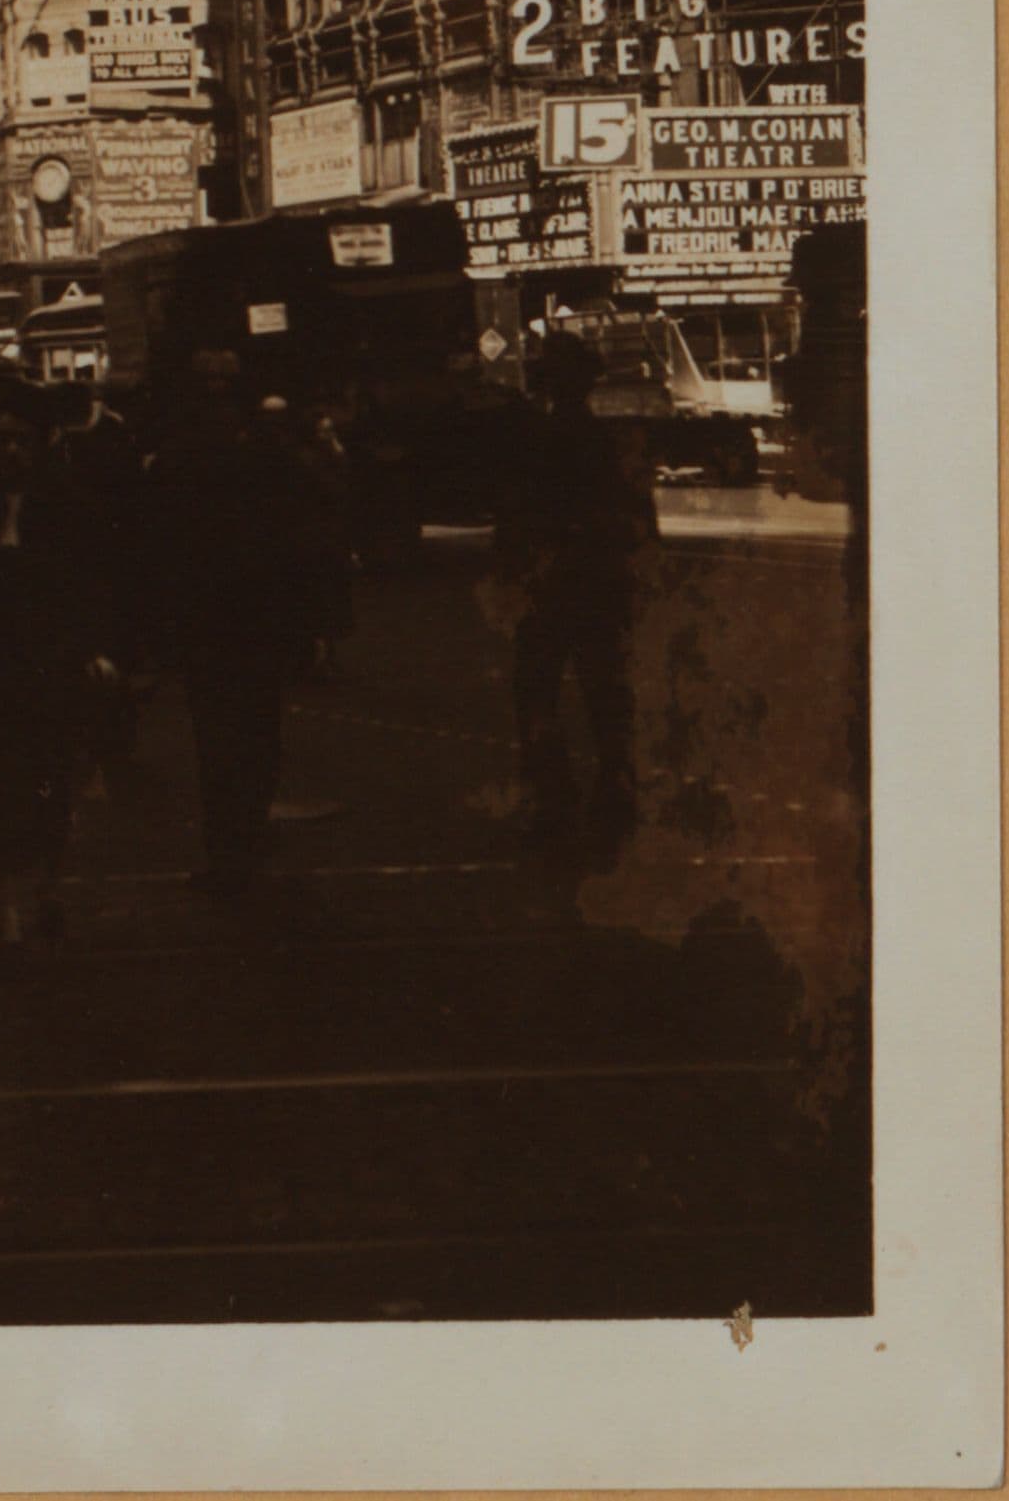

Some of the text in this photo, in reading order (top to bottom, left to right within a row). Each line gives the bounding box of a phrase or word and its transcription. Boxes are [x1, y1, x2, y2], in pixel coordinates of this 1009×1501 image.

[109, 5, 173, 28] BUS
[580, 20, 866, 77] FEATURES
[112, 67, 133, 77] ALL
[767, 84, 828, 105] WITH
[653, 117, 845, 143] GEO. M. COHAN
[100, 157, 189, 176] WAVING
[685, 144, 816, 168] THEATRE
[467, 161, 526, 187] THEATRE
[622, 181, 684, 202] ANNA
[688, 180, 750, 201] STEN
[761, 180, 777, 200] P
[622, 209, 638, 229] A
[644, 206, 736, 229] MENJOU
[741, 205, 789, 227] MAE
[647, 230, 742, 254] FREDRIC
